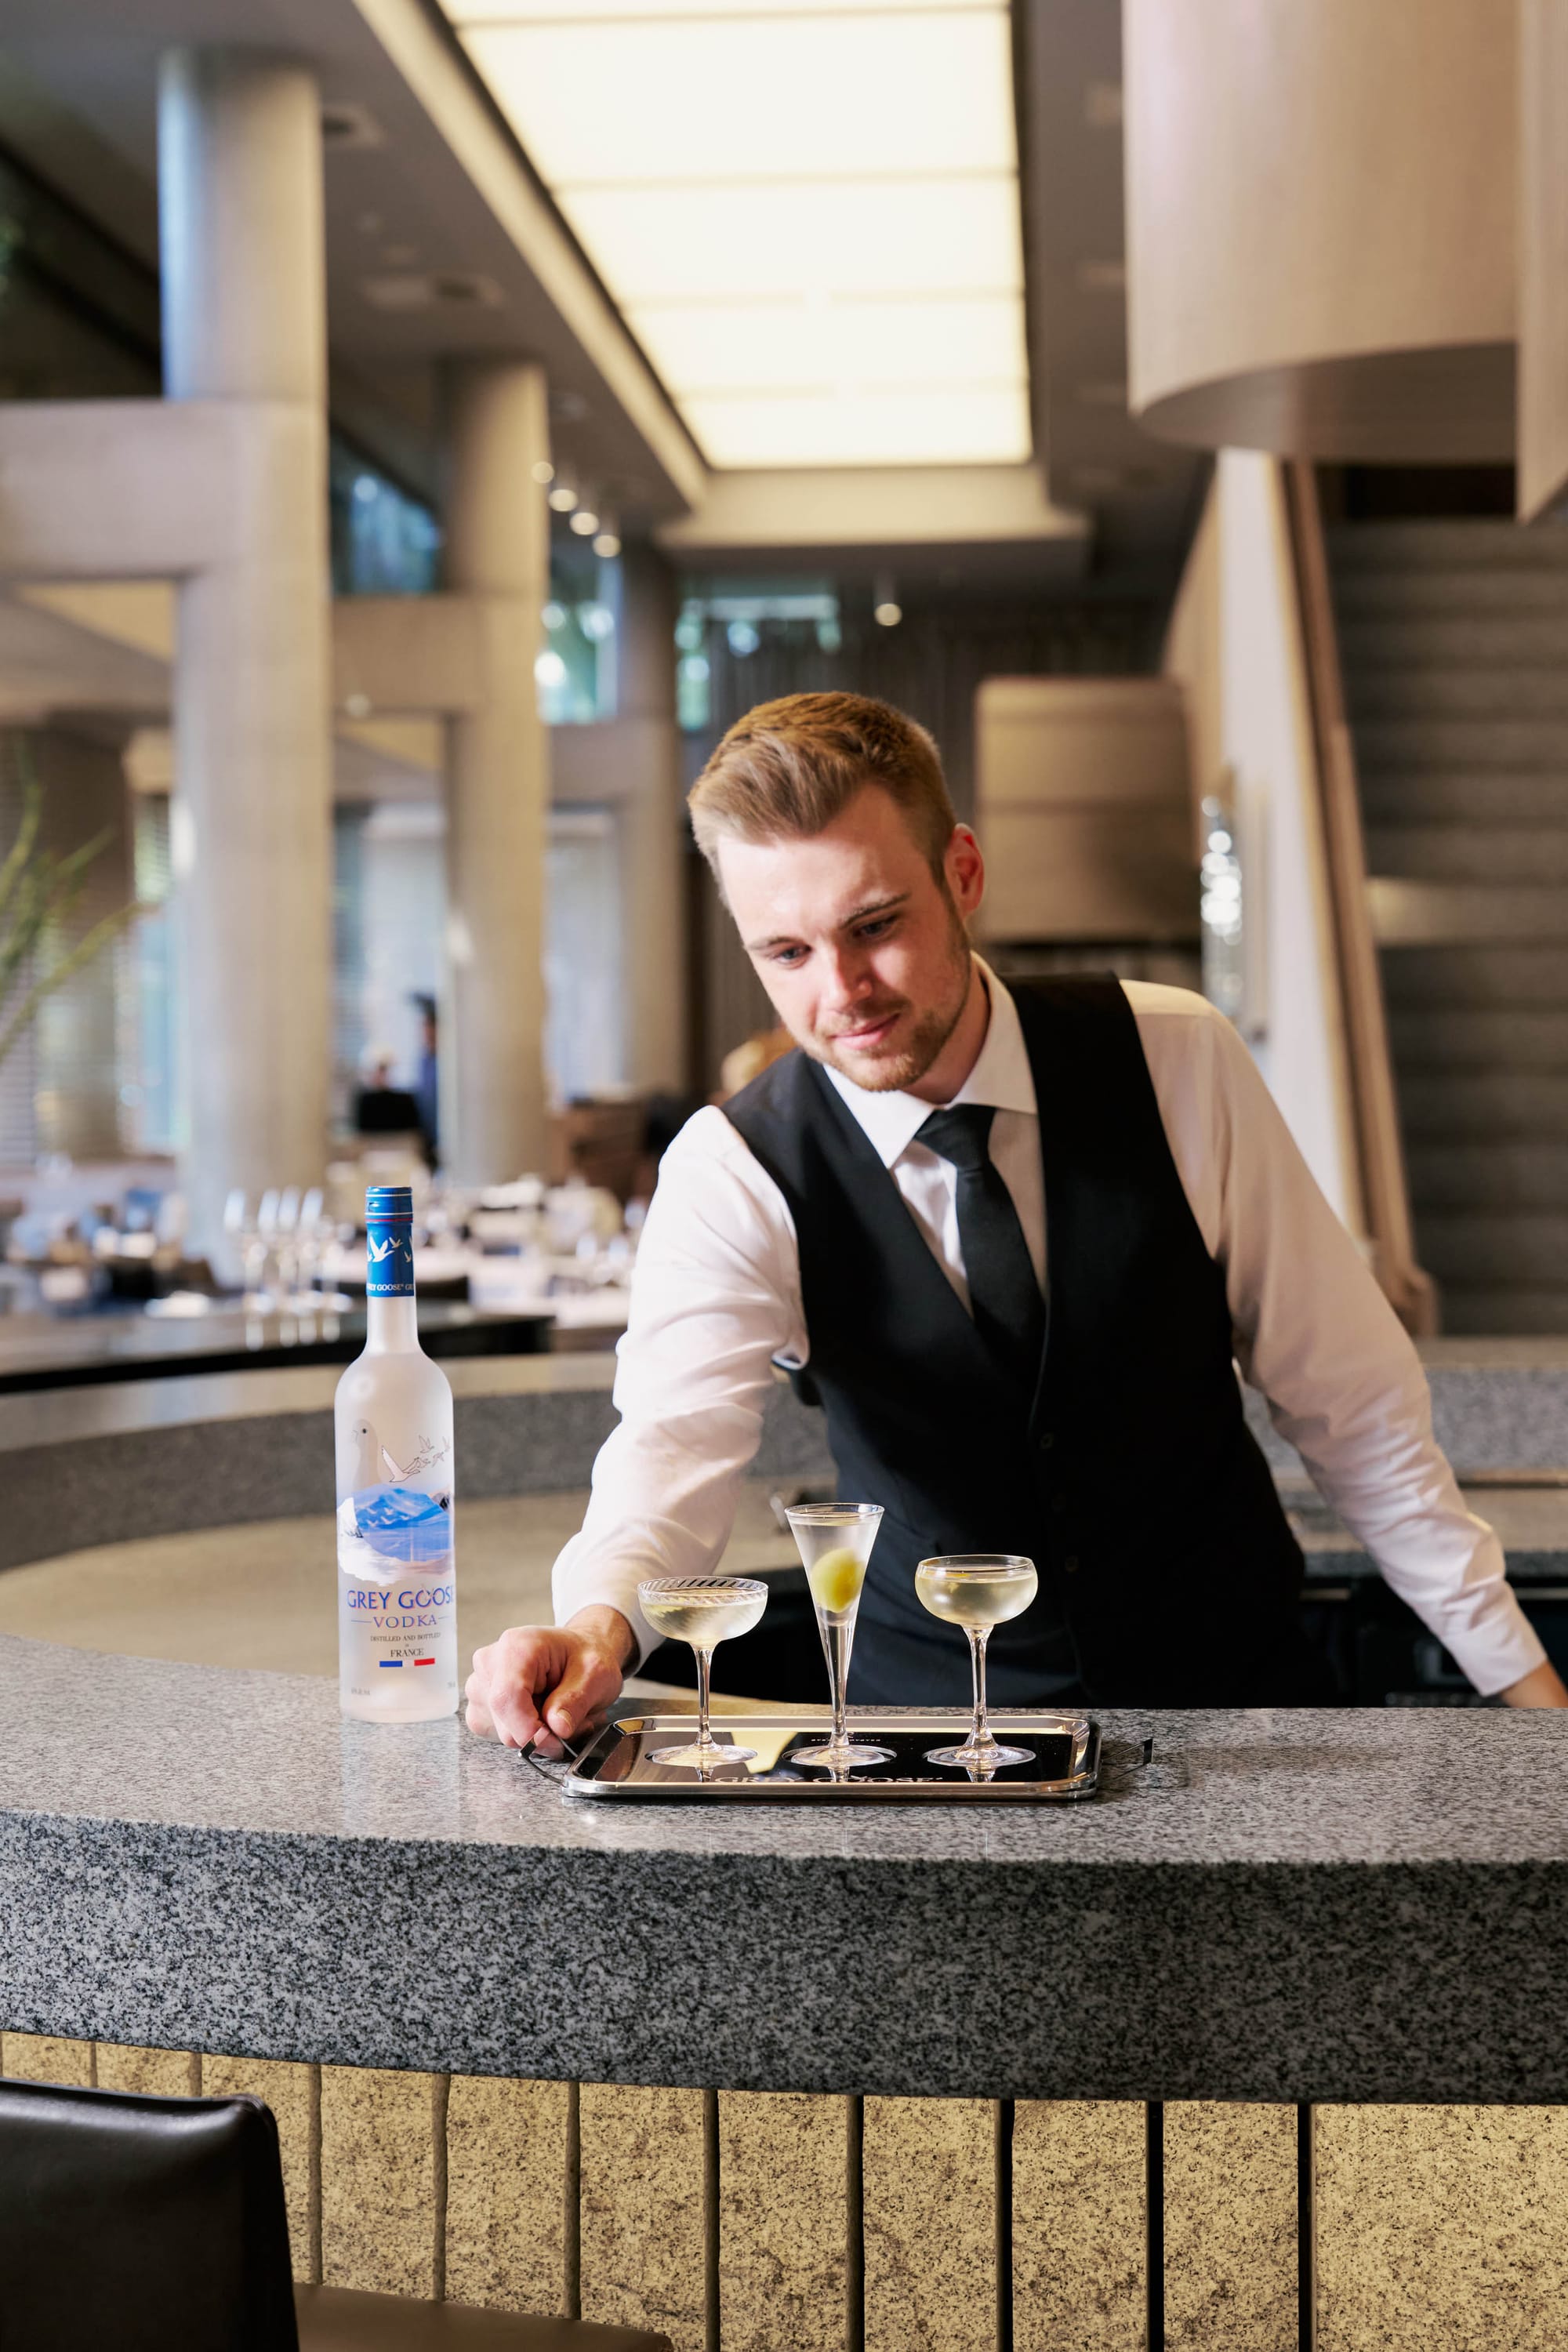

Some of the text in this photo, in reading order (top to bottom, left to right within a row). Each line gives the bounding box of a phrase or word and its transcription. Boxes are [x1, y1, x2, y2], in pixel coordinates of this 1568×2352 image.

[347, 1590, 391, 1610] GREY
[372, 1614, 437, 1629] VODKA
[390, 1648, 425, 1658] FRANCE
